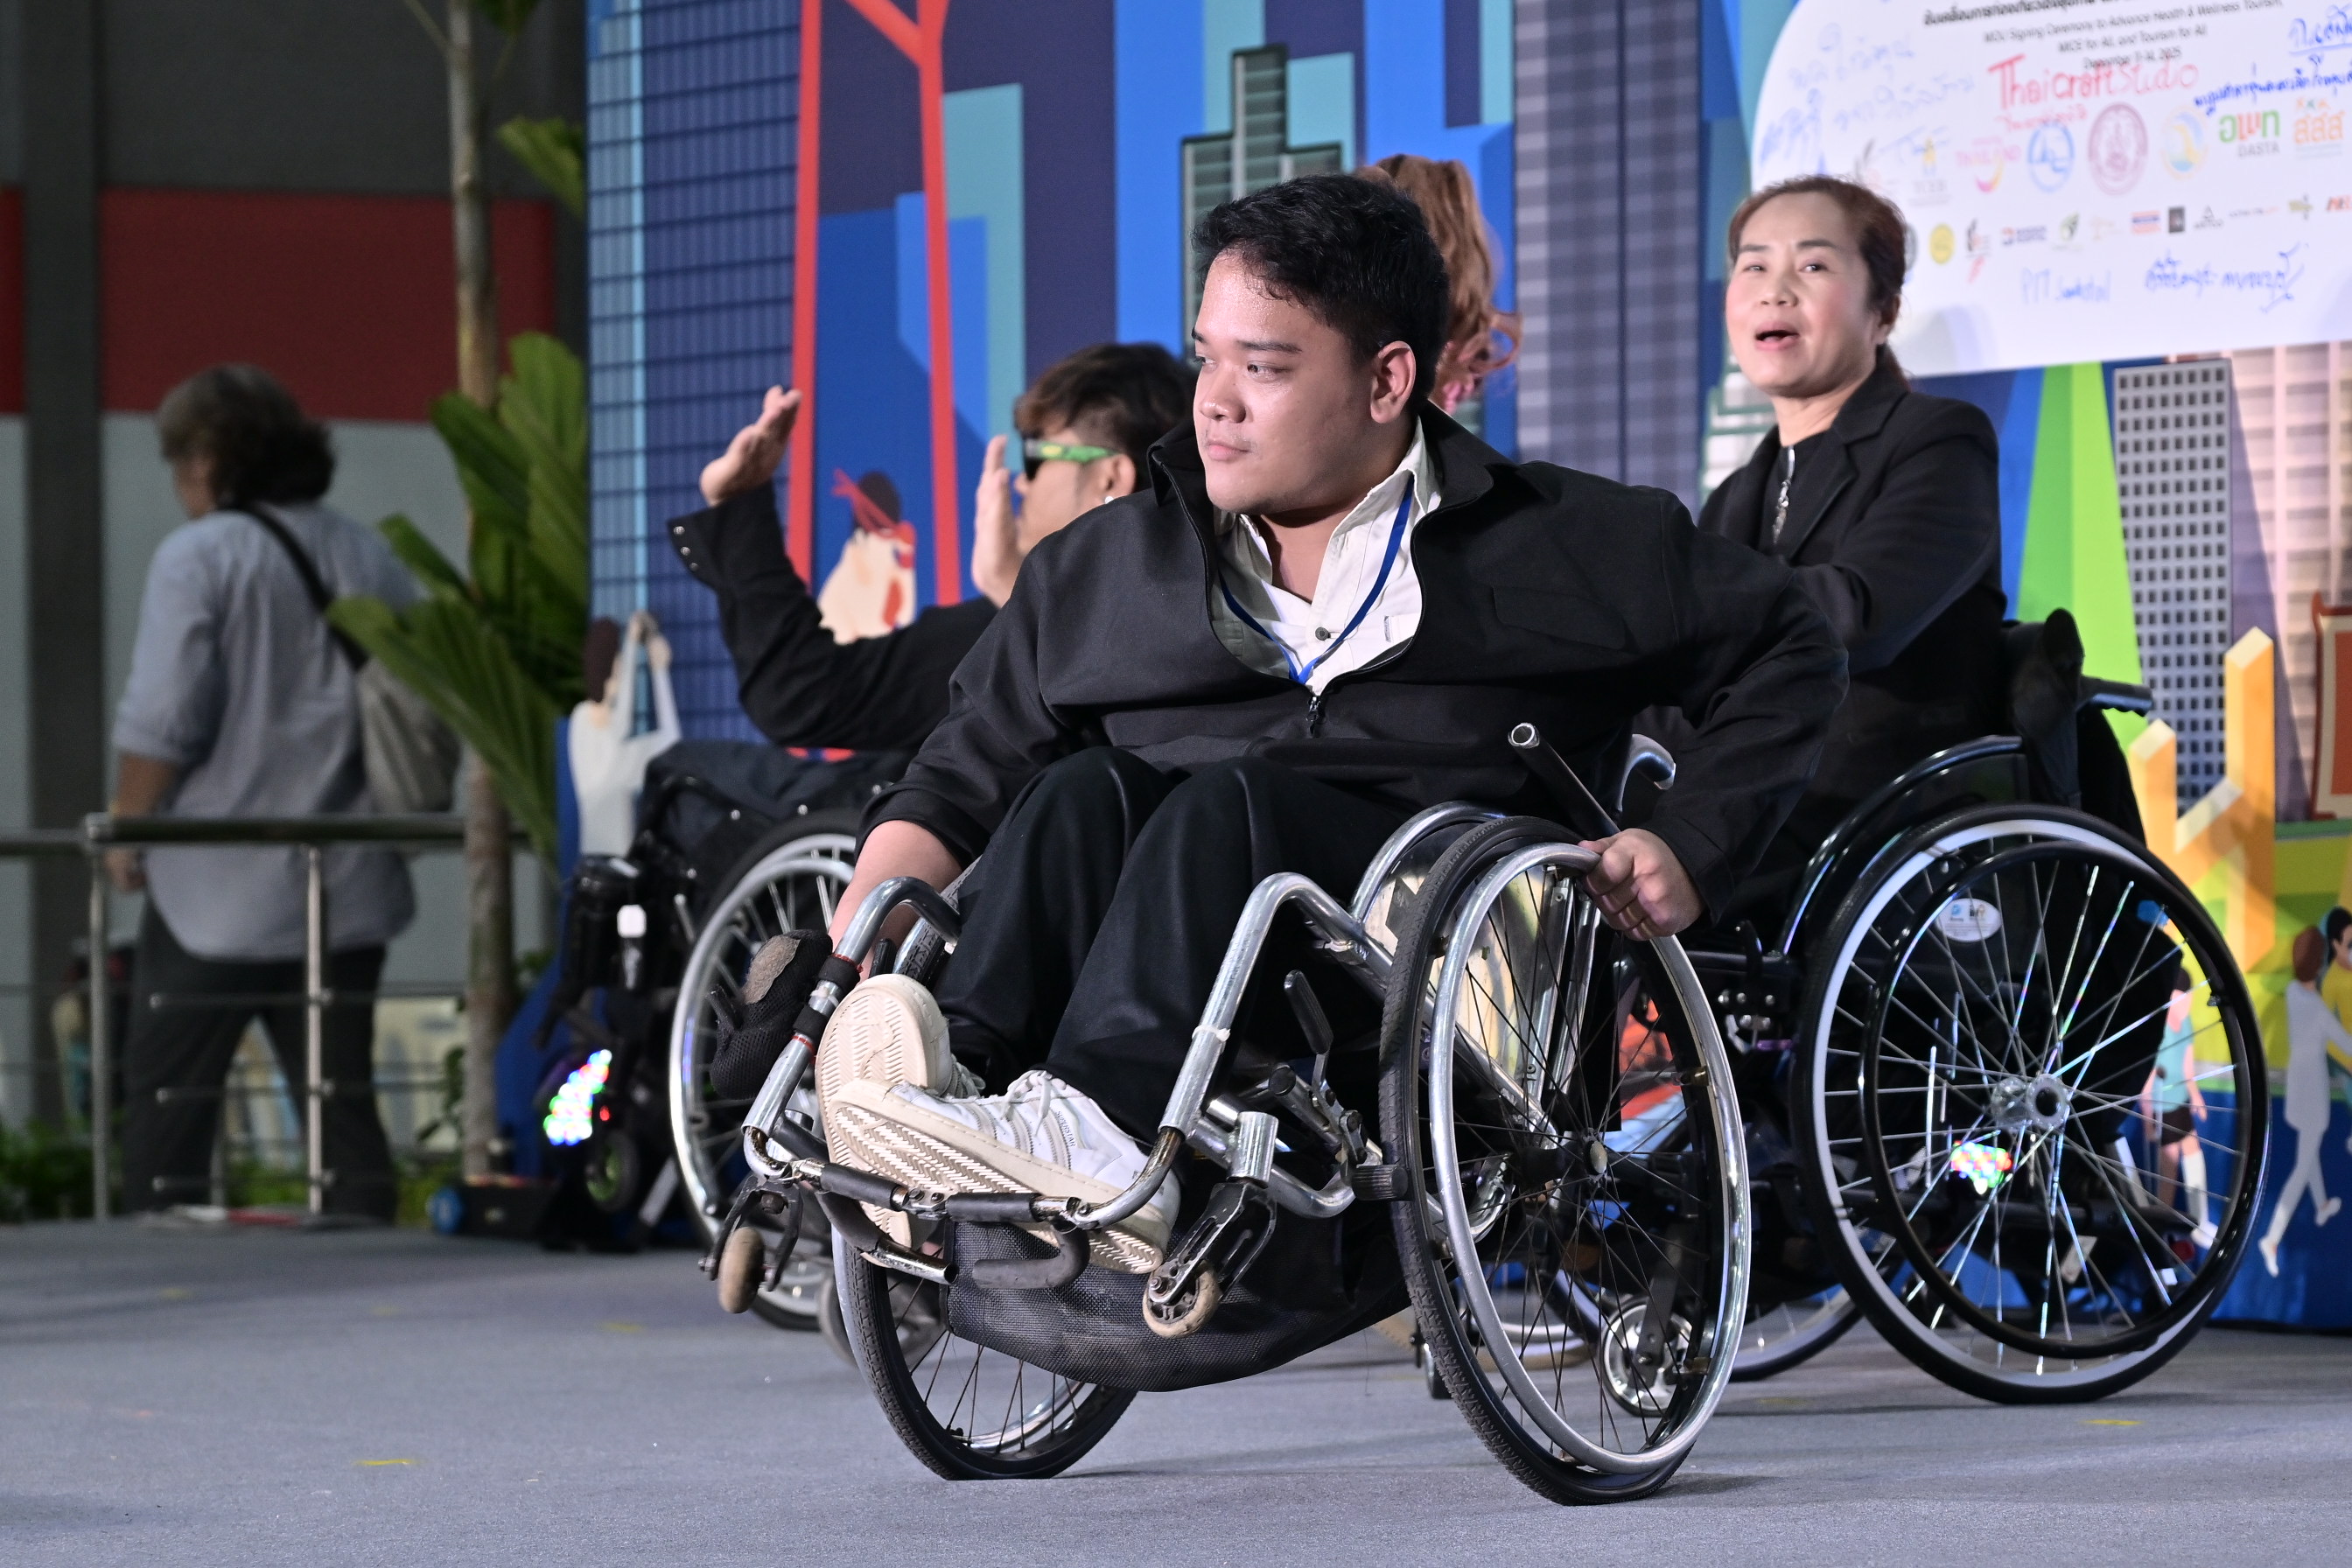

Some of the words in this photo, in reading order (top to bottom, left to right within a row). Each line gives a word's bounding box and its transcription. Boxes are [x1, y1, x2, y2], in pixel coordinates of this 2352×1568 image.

[2009, 26, 2044, 41] Signing
[2047, 20, 2093, 37] Ceremony
[2096, 18, 2107, 29] to
[2110, 13, 2149, 27] Advance
[2153, 8, 2186, 21] Health
[2198, 1, 2241, 16] Wellness
[2086, 38, 2097, 50] for
[2118, 34, 2138, 46] and
[2139, 28, 2176, 43] Tourism
[2178, 25, 2191, 38] for
[2237, 141, 2280, 158] DASTA
[1054, 1110, 1076, 1147] SUPERSTAR
